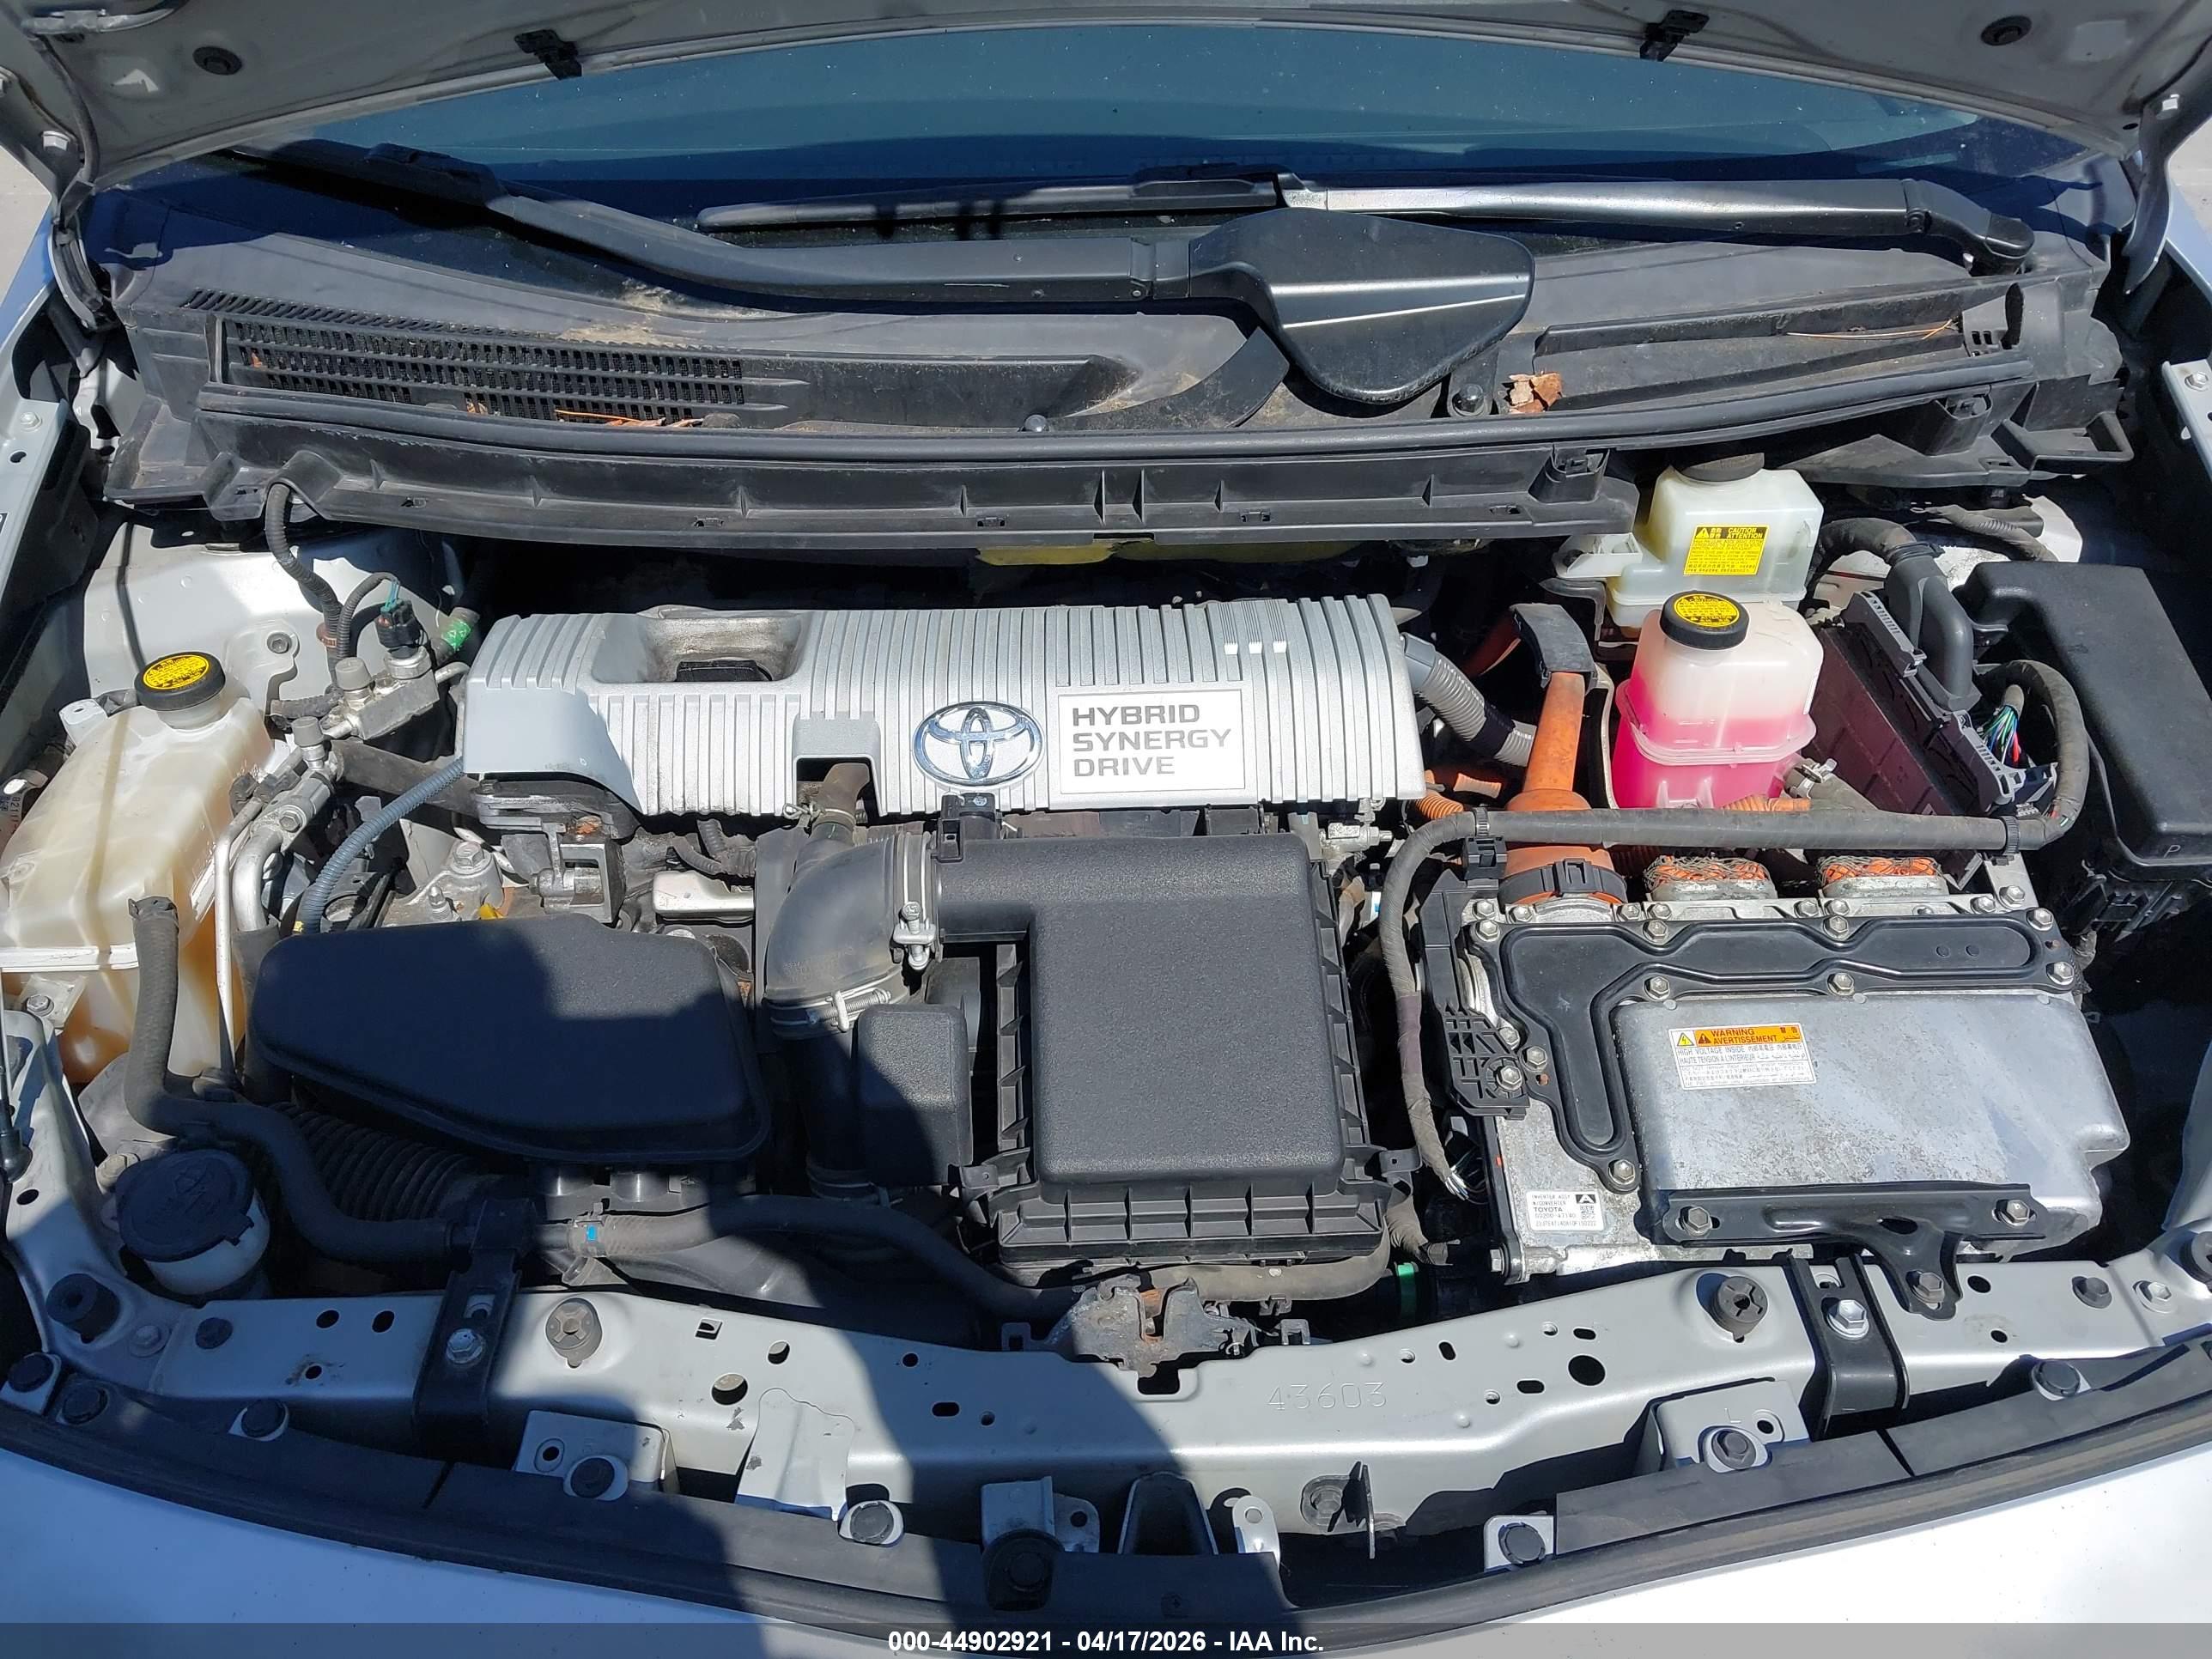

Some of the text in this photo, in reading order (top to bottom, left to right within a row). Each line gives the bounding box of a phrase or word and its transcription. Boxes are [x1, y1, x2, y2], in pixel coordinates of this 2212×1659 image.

[1073, 704, 1200, 726] HYBRID
[1073, 728, 1232, 752] SYNERGY
[1073, 756, 1176, 777] DRIVE
[2163, 844, 2181, 859] P
[1711, 1028, 1755, 1037] WARNING
[1713, 1035, 1778, 1045] AVERTISSEMENT
[1678, 1048, 1692, 1056] HIGH
[1267, 1381, 1387, 1411] 43603
